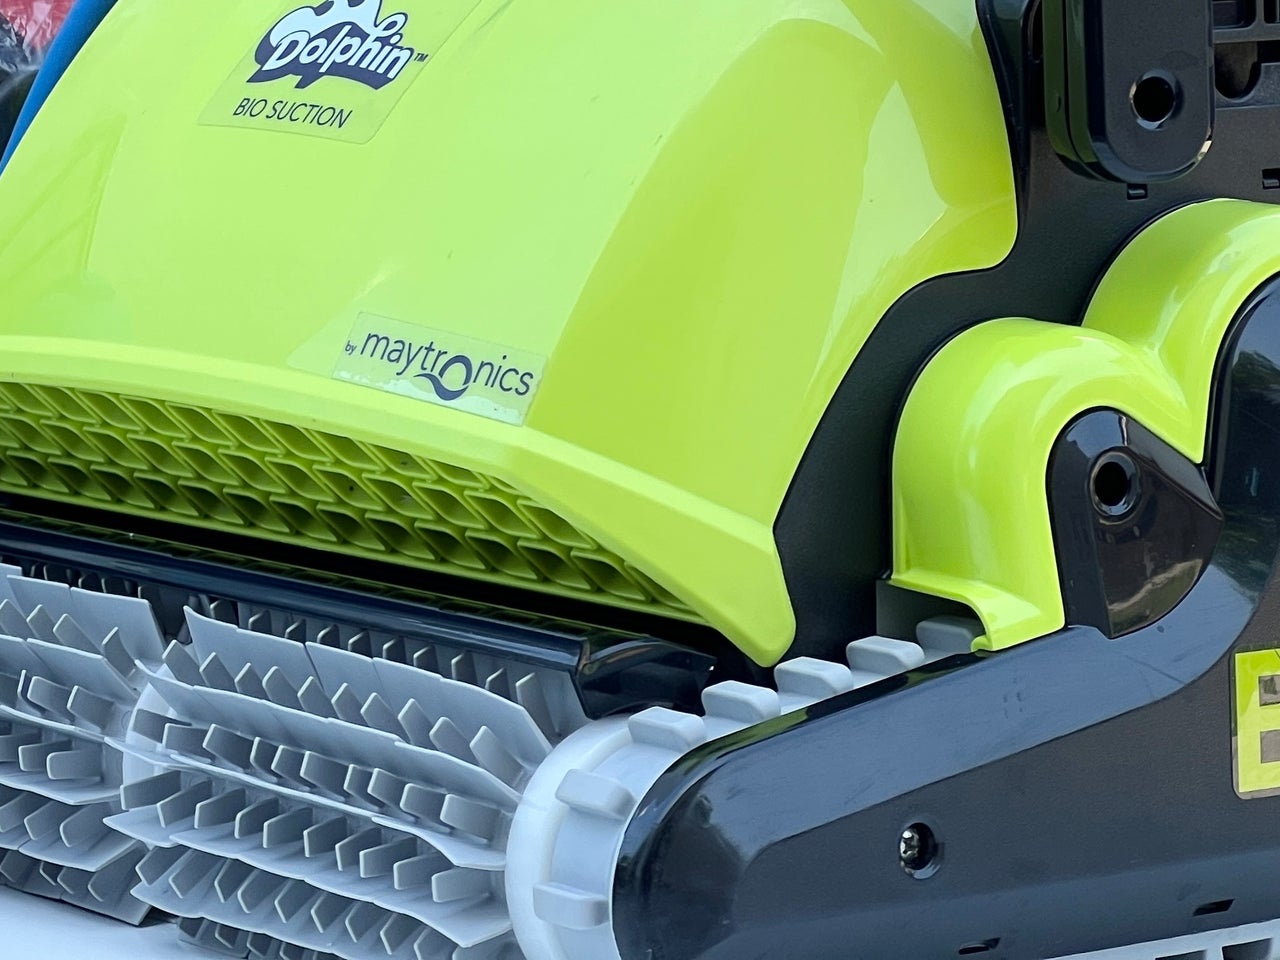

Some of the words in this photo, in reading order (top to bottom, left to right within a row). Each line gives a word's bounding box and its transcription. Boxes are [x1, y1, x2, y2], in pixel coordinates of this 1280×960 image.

[261, 23, 414, 80] Dolphin
[233, 97, 268, 118] BIO
[265, 100, 353, 129] SUCTION
[344, 340, 358, 356] by
[360, 332, 535, 401] maytronics
